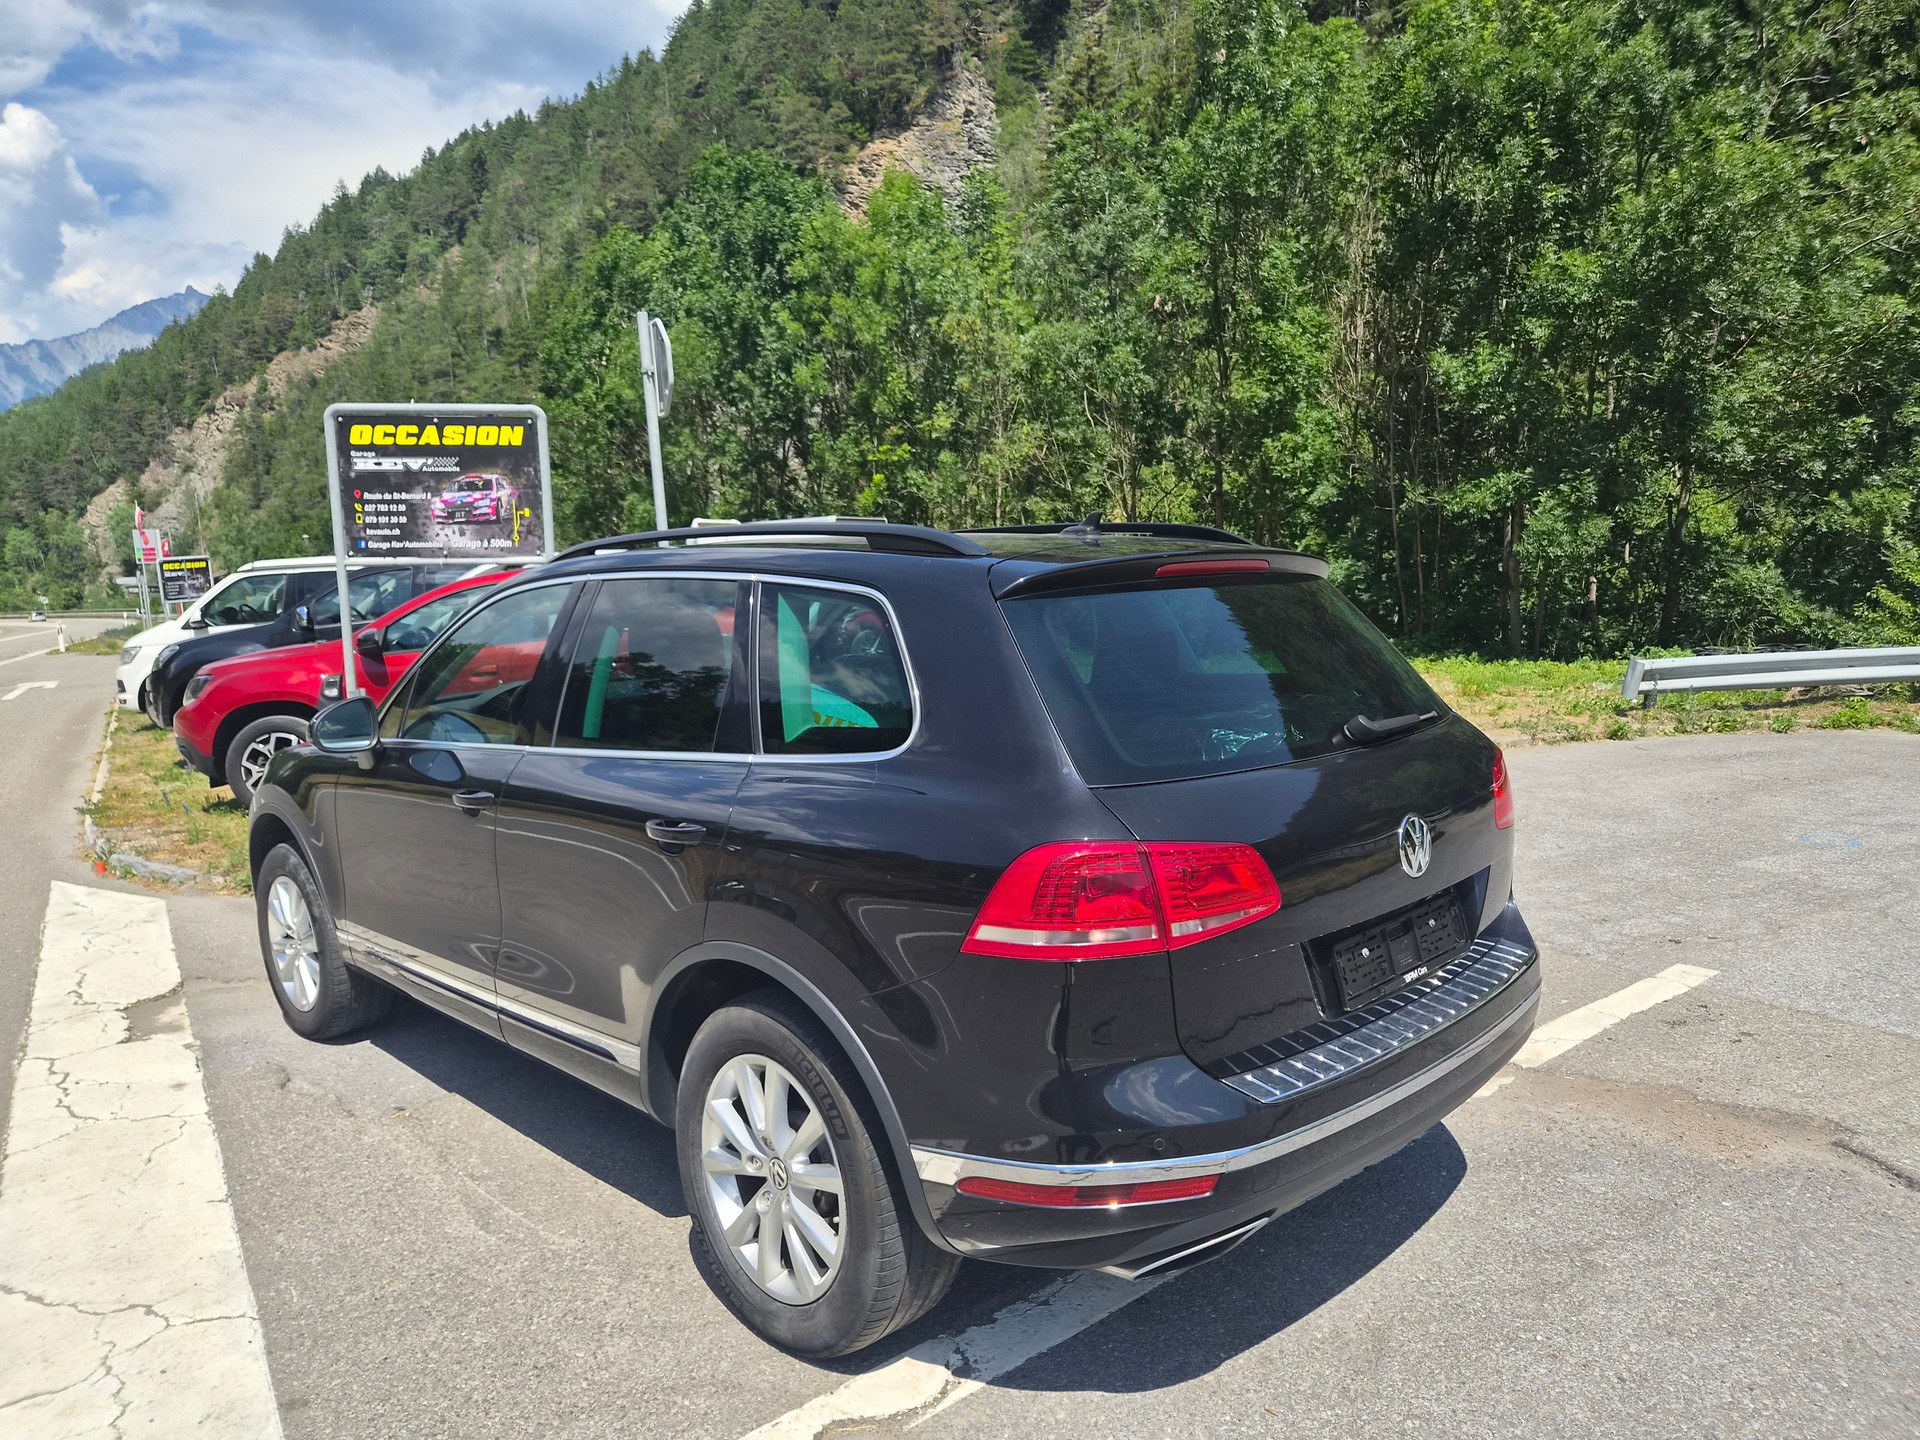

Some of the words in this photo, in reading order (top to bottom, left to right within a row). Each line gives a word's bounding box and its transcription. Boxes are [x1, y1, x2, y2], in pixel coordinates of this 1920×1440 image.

[350, 424, 524, 446] OCCASION
[383, 491, 392, 500] du
[364, 503, 376, 512] 027
[389, 503, 397, 512] 12
[378, 515, 389, 524] 101
[367, 540, 391, 550] Garage
[452, 539, 482, 550] Garage
[483, 538, 489, 548] à
[490, 538, 513, 548] 500m
[162, 561, 207, 571] OCCASION
[781, 1040, 846, 1135] MICHELIN
[845, 1154, 859, 1195] PILOT
